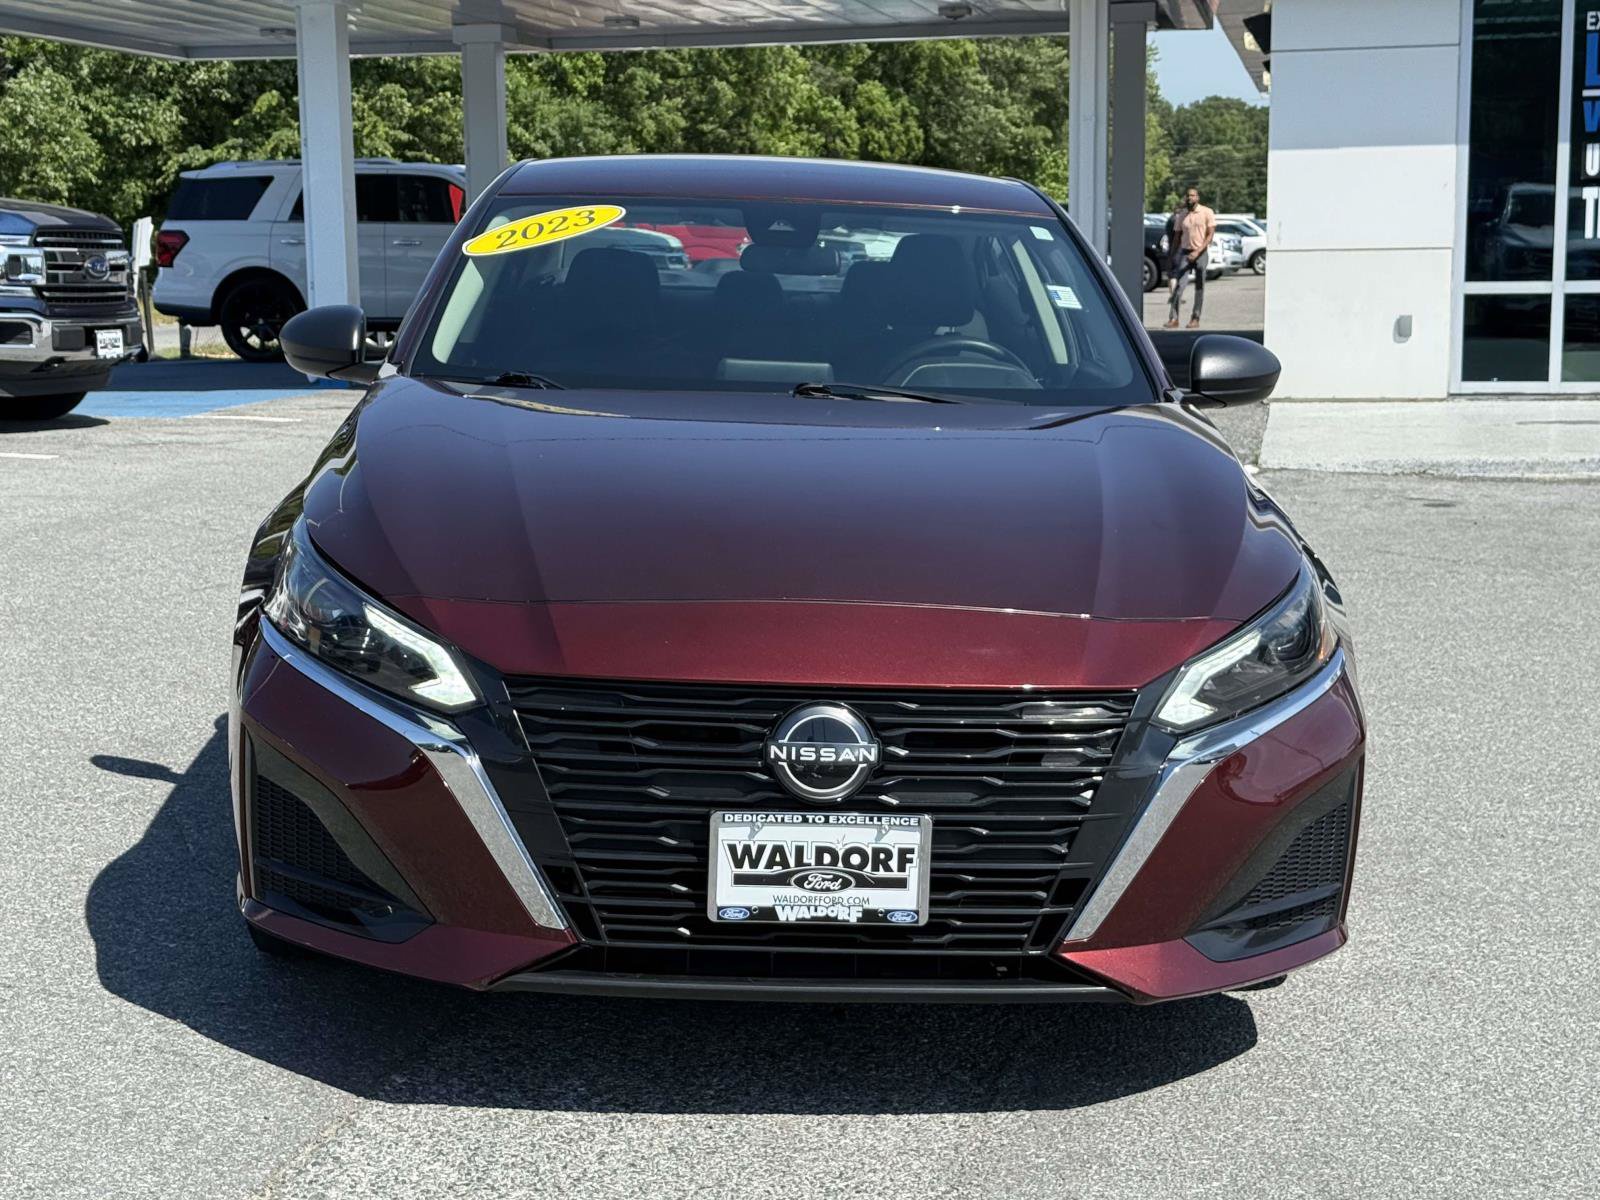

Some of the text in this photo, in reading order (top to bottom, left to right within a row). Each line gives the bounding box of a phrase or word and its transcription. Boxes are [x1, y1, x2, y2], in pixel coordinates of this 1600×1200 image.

[496, 209, 596, 250] 2023
[770, 745, 875, 762] NISSAN
[724, 813, 919, 827] DEDICATED TO EXCELLENCE
[727, 843, 916, 873] WALDORF
[803, 873, 842, 891] Ford
[773, 894, 870, 906] WALDORFFORD.COM
[774, 904, 863, 923] WALDORF
